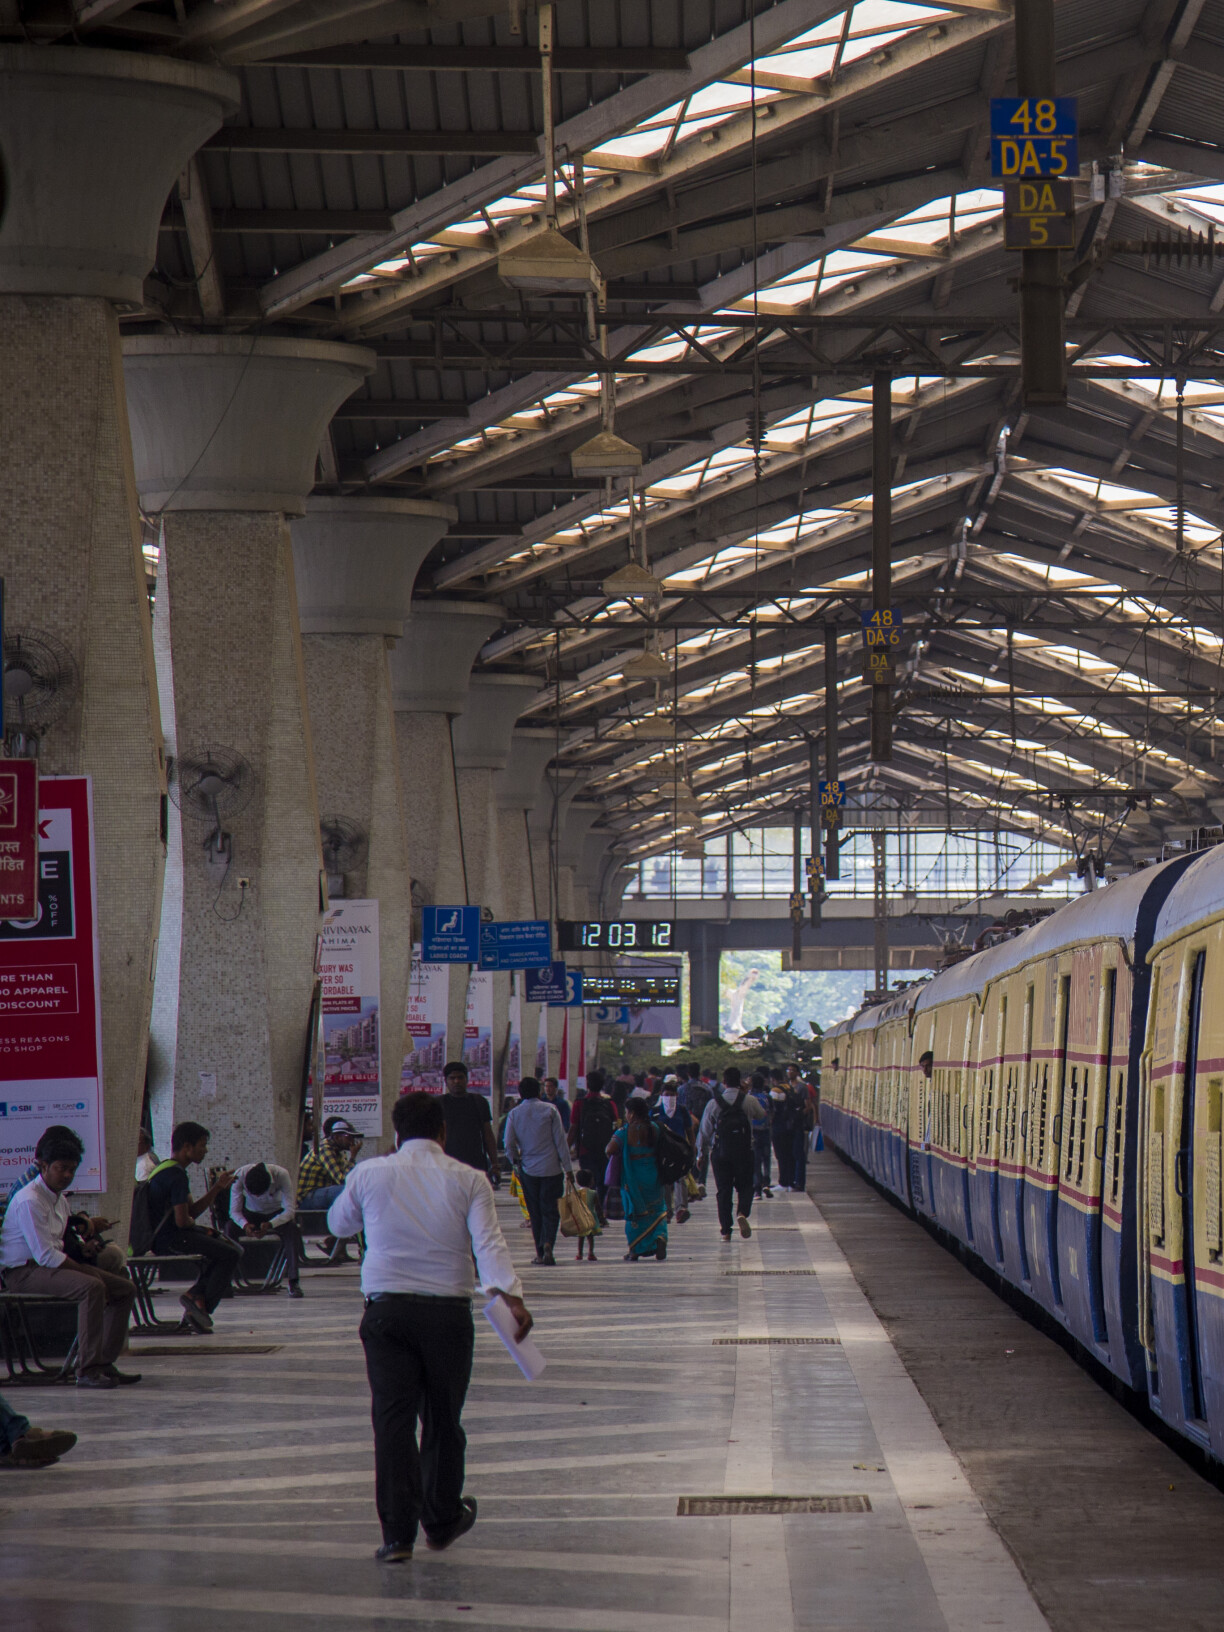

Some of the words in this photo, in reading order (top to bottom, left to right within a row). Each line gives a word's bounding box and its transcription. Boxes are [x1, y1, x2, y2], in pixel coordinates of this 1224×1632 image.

[1010, 99, 1057, 134] 48
[1001, 141, 1068, 175] DA-5
[1019, 184, 1057, 211] DA
[1029, 218, 1049, 245] 5
[870, 610, 893, 626] 48
[866, 628, 900, 646] DA-6
[870, 654, 888, 668] DA
[875, 670, 884, 683] 6
[824, 782, 840, 793] 48
[821, 793, 843, 805] DA-7
[825, 810, 838, 820] DA
[582, 923, 601, 947] 12
[608, 923, 636, 947] 03
[652, 923, 671, 947] 12
[19, 973, 54, 982] THAN
[14, 986, 69, 996] APPAREL
[0, 1000, 60, 1010] DISCOUNT
[20, 1035, 70, 1044] REASONS
[14, 1045, 43, 1053] SHOP
[323, 1104, 350, 1113] 93222
[352, 1103, 378, 1112] 56777
